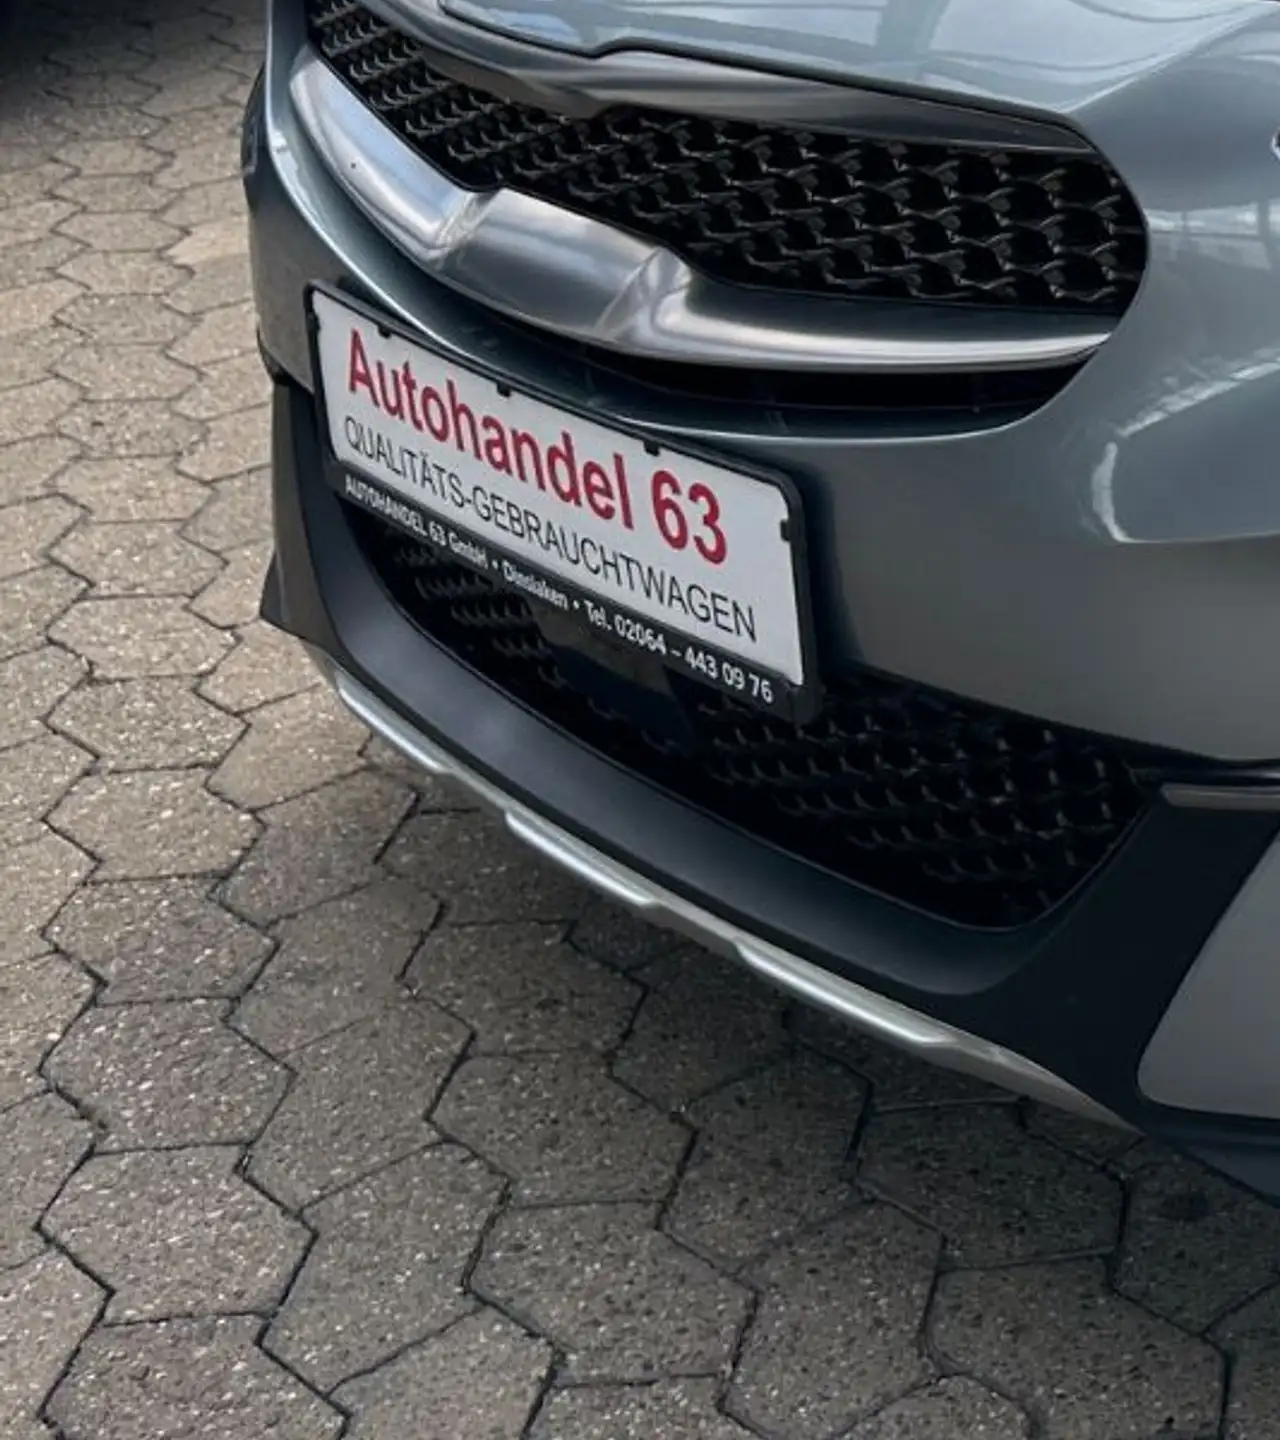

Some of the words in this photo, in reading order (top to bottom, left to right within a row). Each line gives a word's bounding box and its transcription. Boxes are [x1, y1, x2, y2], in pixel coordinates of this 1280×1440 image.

[345, 416, 757, 643] QUALITÄTS-GEBRAUCHTWAGEN
[348, 329, 634, 528] Autohandel
[651, 470, 728, 564] 63
[344, 474, 428, 537] AUTOHANDEL
[429, 521, 447, 546] 63
[448, 532, 489, 571] GmbH
[584, 600, 612, 630] Tel.
[614, 614, 666, 655] 02064
[684, 646, 718, 680] 443
[722, 664, 745, 690] 09
[749, 674, 774, 703] 76
